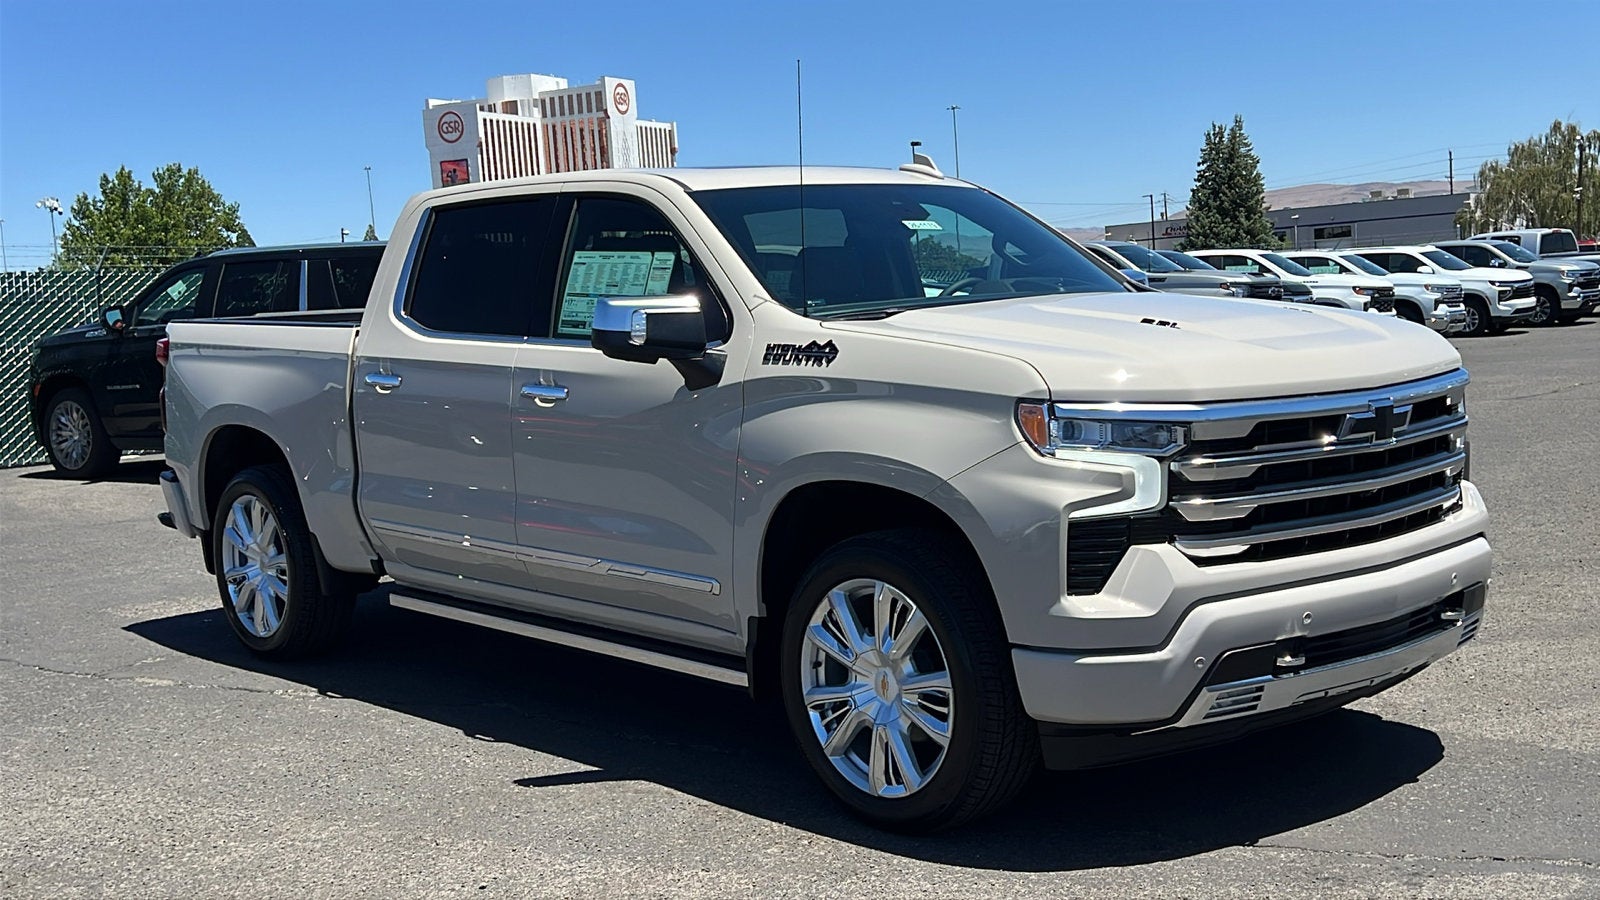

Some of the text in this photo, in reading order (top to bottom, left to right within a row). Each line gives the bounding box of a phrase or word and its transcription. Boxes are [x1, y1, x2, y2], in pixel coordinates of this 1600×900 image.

[615, 91, 628, 106] GSR
[441, 120, 461, 135] GSR
[764, 343, 803, 354] HIGH
[762, 353, 837, 368] COUNTRY
